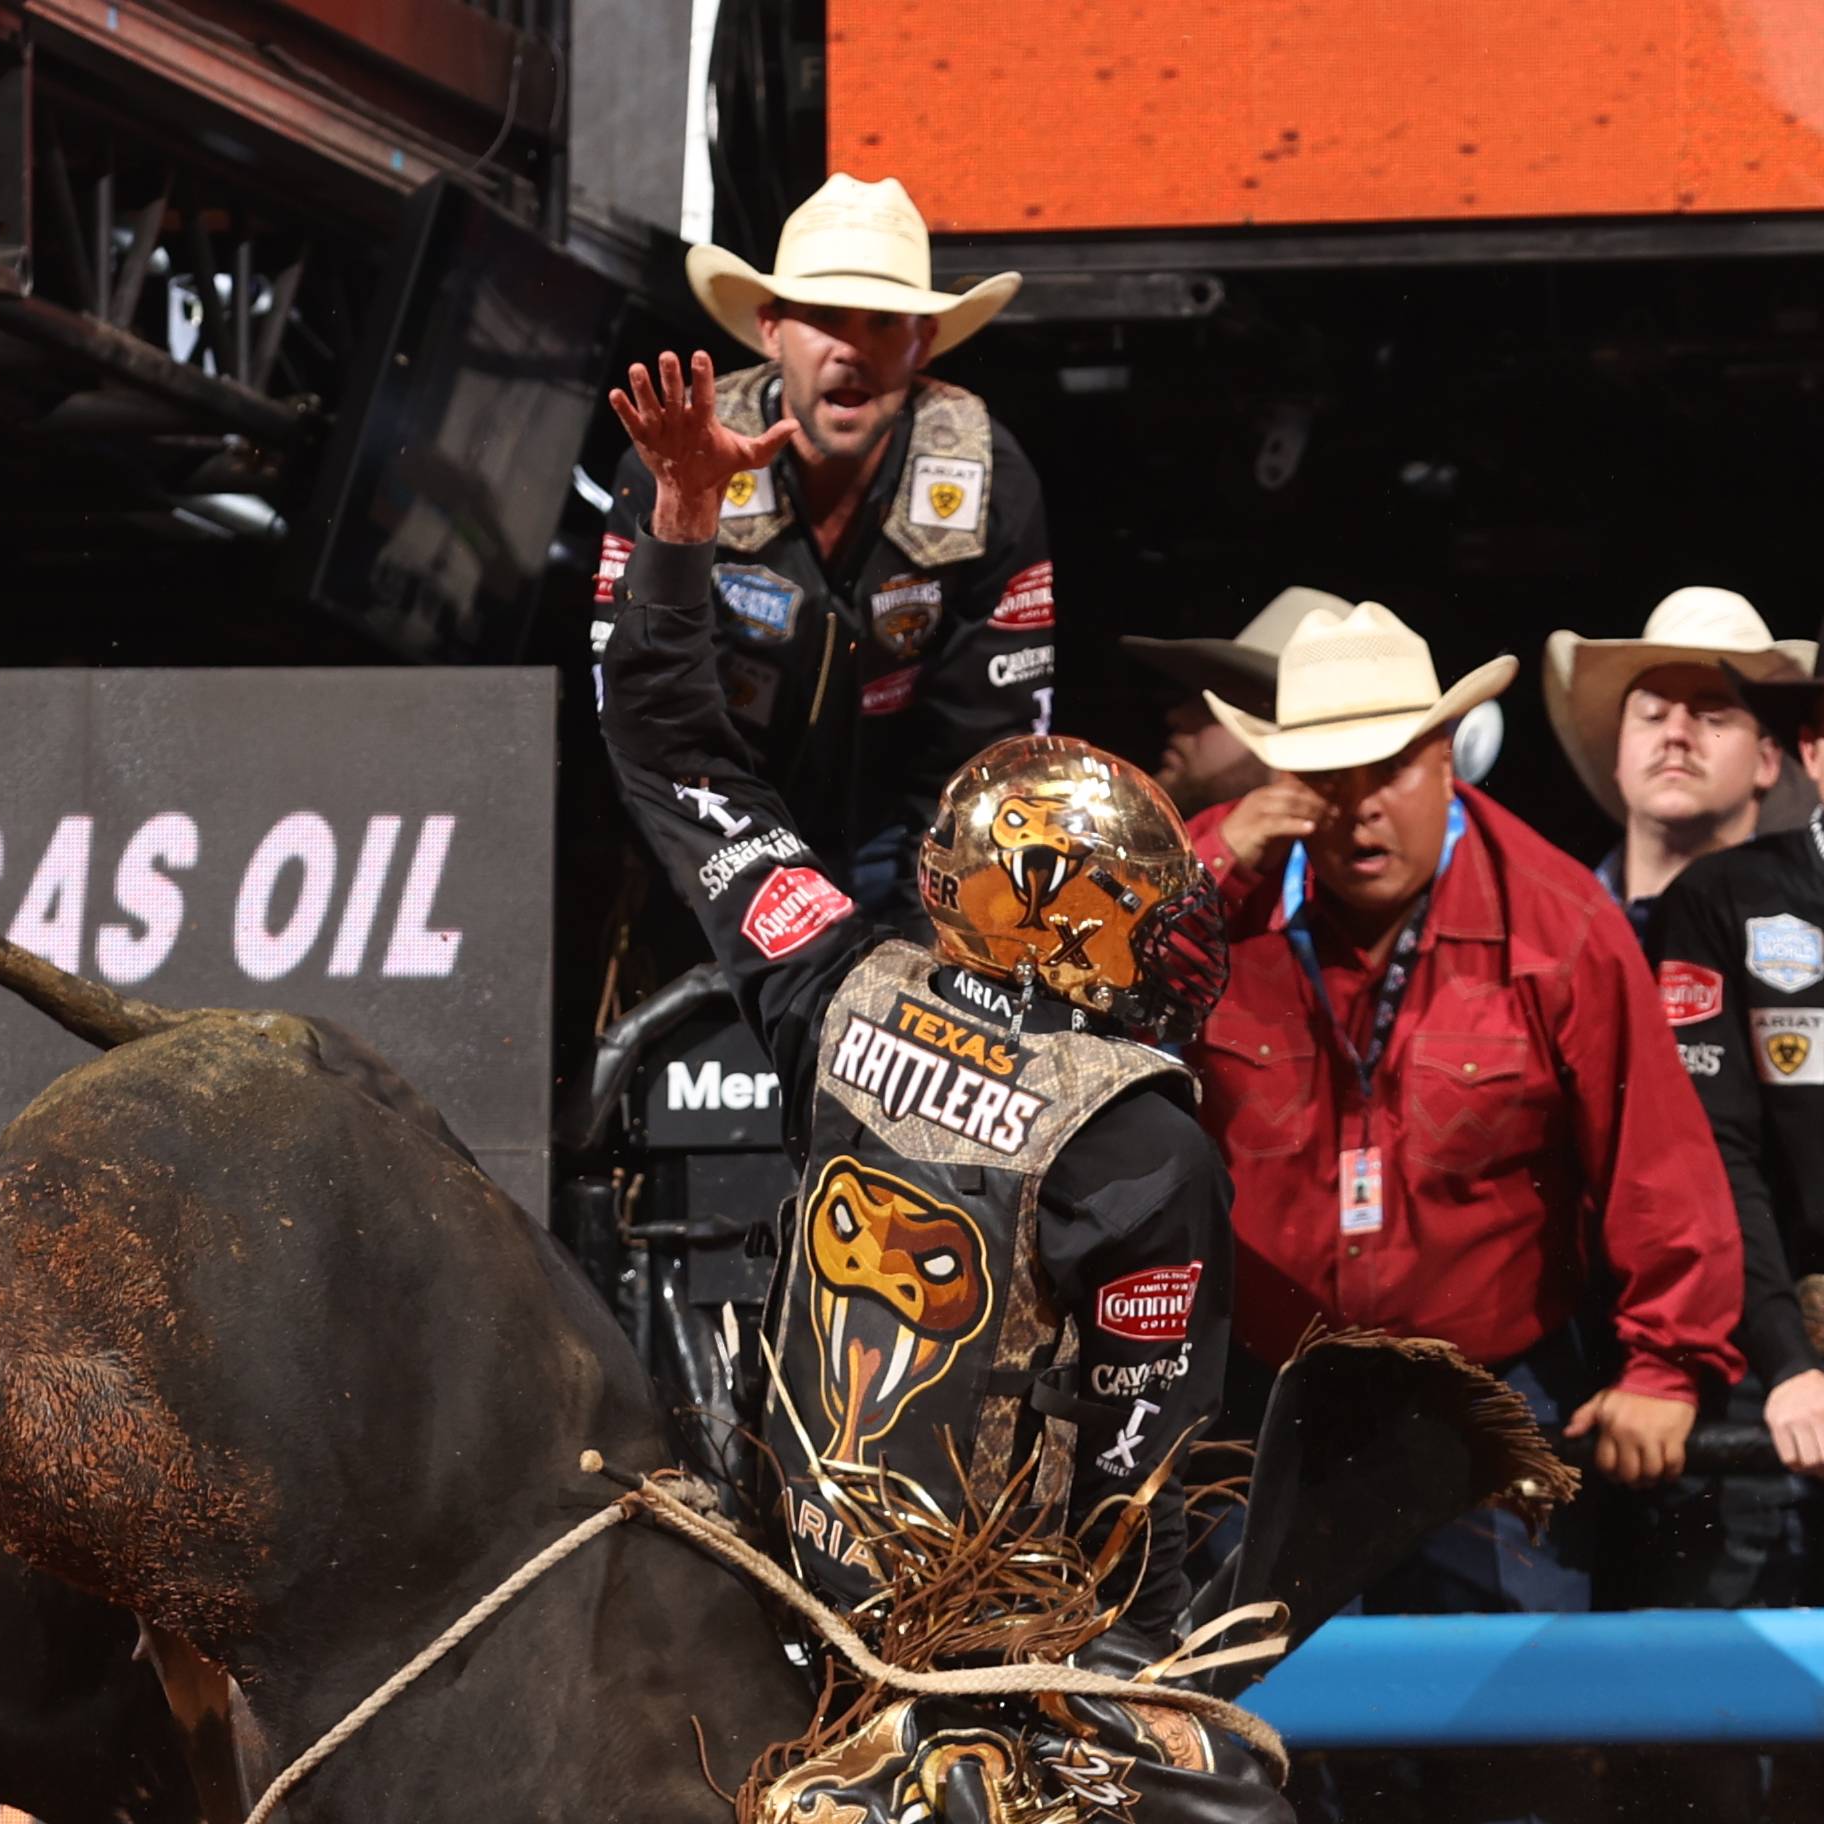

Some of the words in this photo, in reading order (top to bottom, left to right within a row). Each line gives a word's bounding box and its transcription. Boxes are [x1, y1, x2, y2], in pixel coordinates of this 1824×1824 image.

[234, 811, 463, 983] OIL
[953, 970, 1012, 1019] ARIA
[1754, 1015, 1824, 1028] ARIAT
[898, 1002, 1015, 1076] TEXAS
[667, 1060, 783, 1111] Mer
[831, 1015, 1045, 1154] RATTLERS
[1104, 1291, 1191, 1323] Commu
[781, 1486, 882, 1581] RIA
